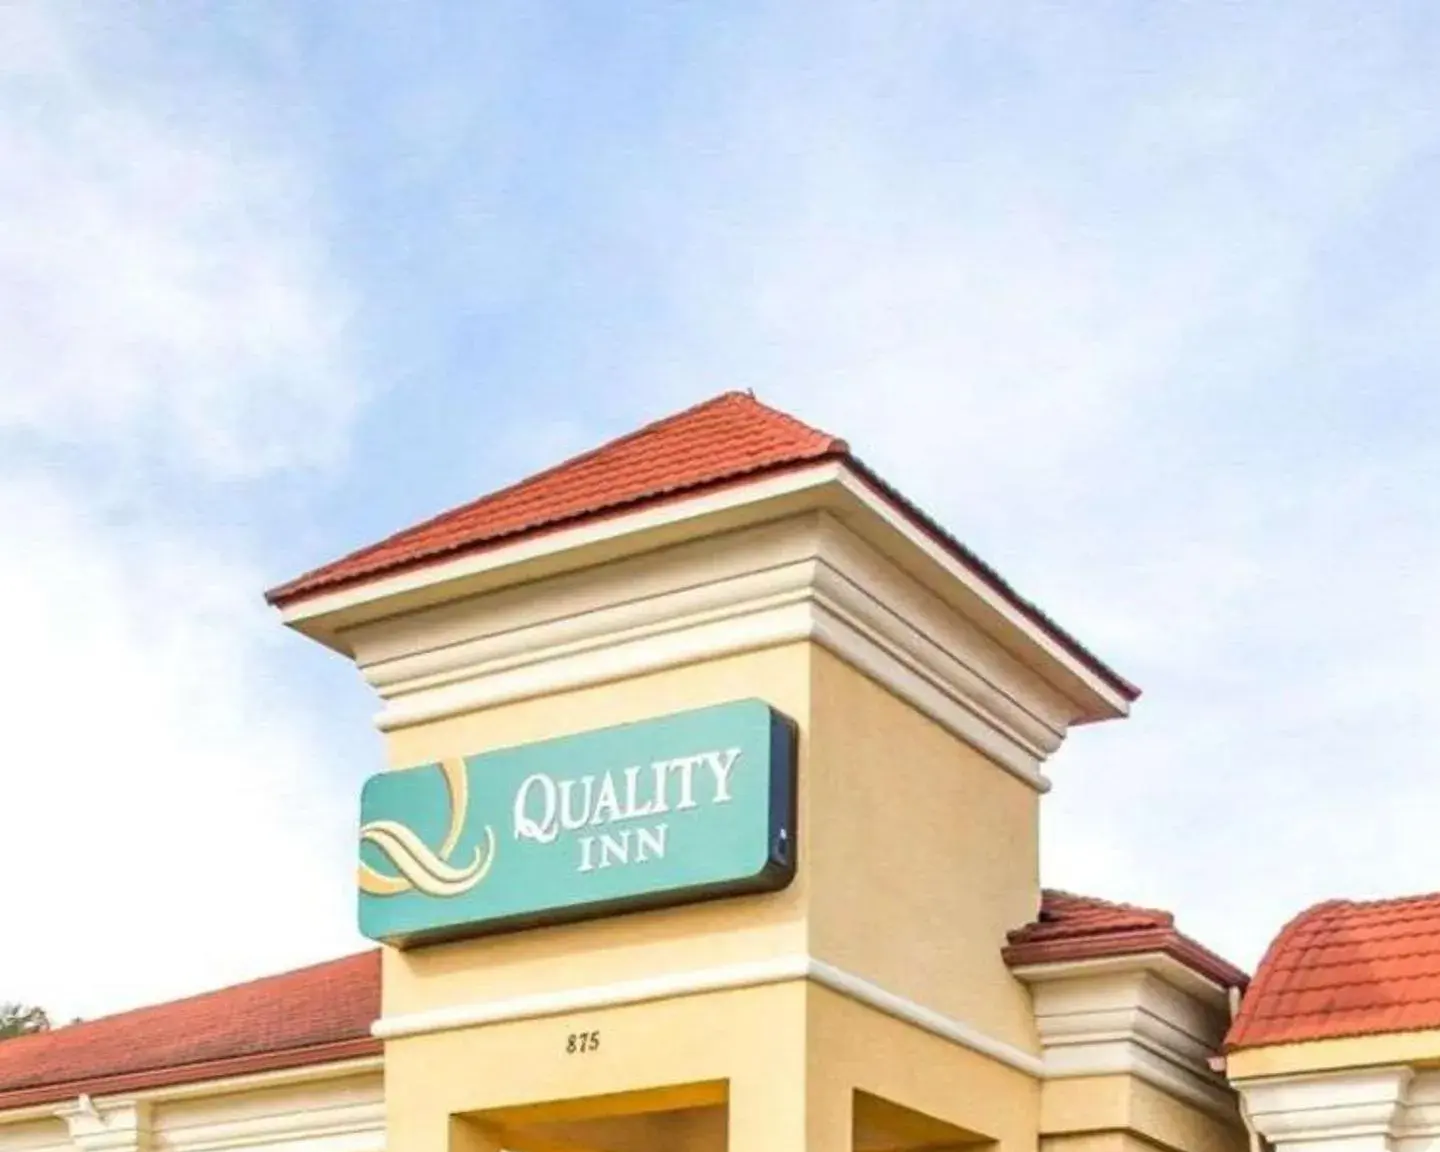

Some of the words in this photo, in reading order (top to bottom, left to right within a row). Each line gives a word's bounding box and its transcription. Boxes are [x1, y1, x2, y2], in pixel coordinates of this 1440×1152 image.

[514, 748, 742, 842] QUALITY
[578, 825, 669, 872] INN
[566, 1031, 600, 1054] 875
